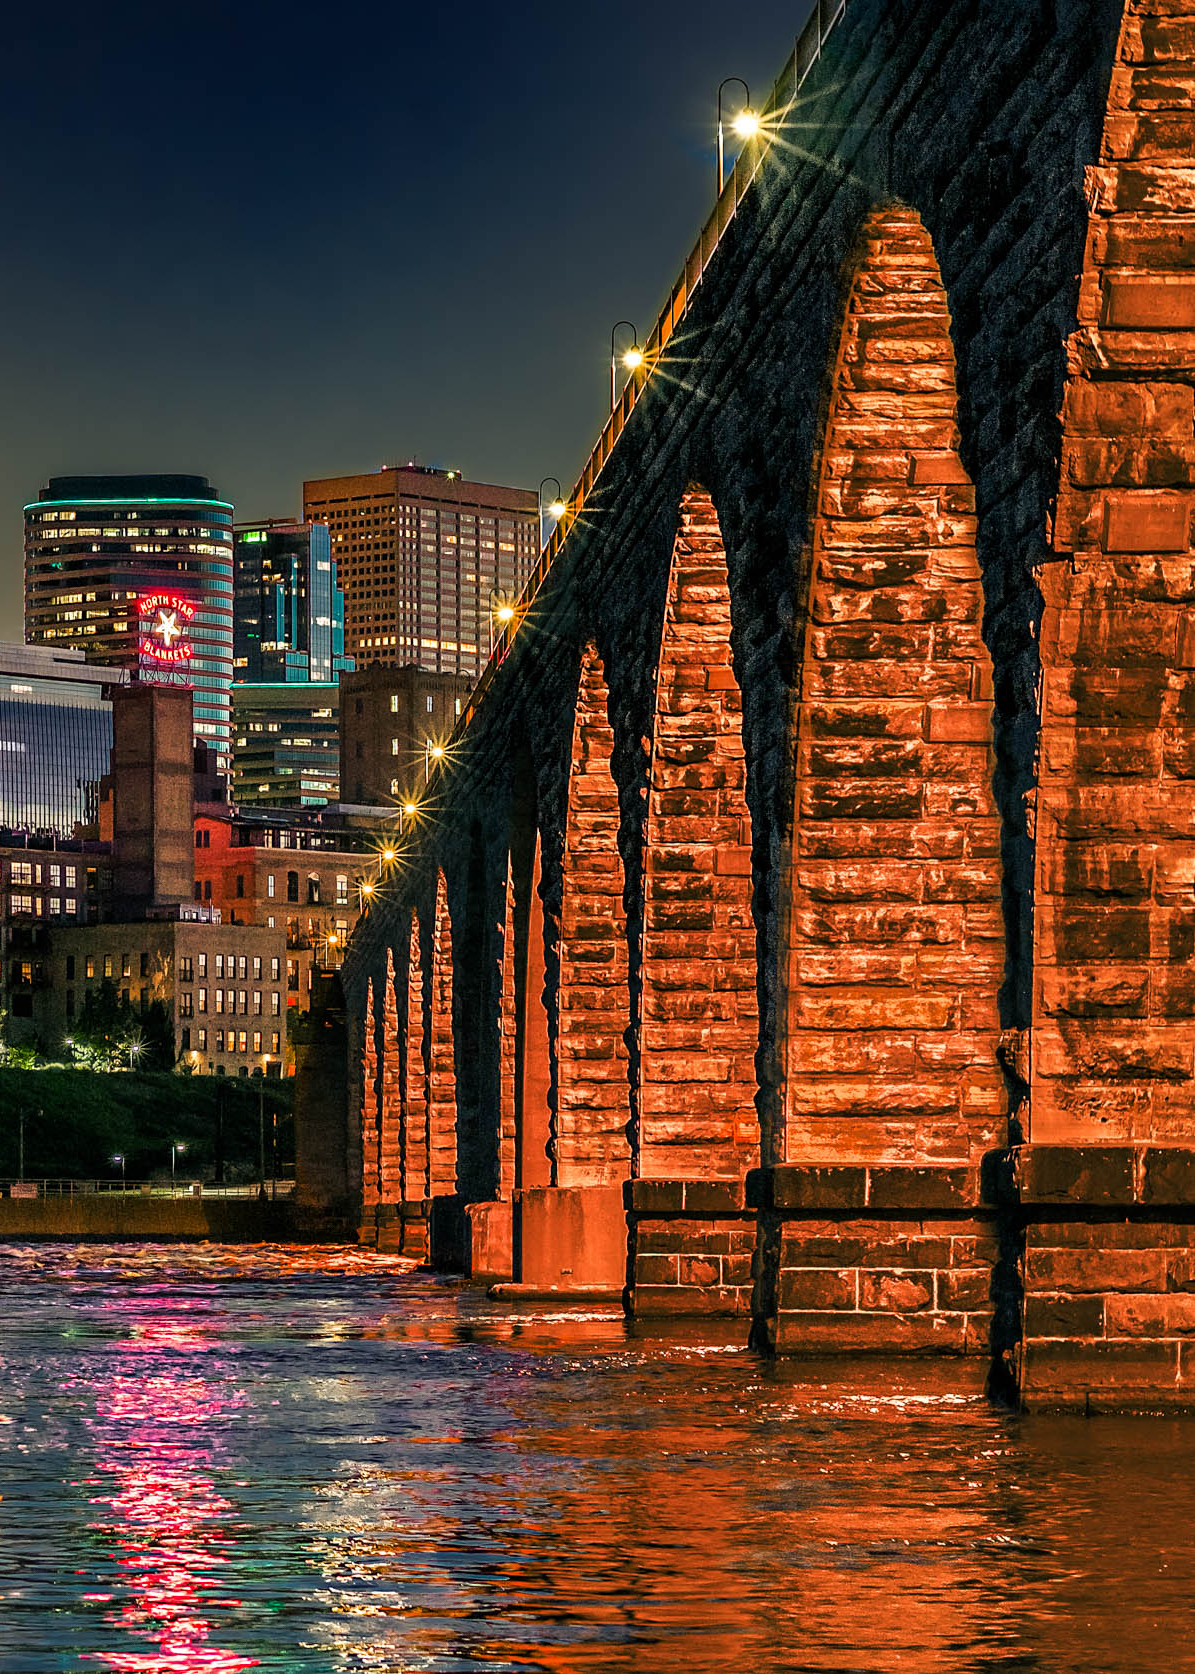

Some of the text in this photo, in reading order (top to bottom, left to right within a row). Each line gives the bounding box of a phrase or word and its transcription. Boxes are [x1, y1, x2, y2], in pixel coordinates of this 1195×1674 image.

[140, 595, 194, 618] NORTH STAR
[144, 641, 191, 661] BLANKETS
